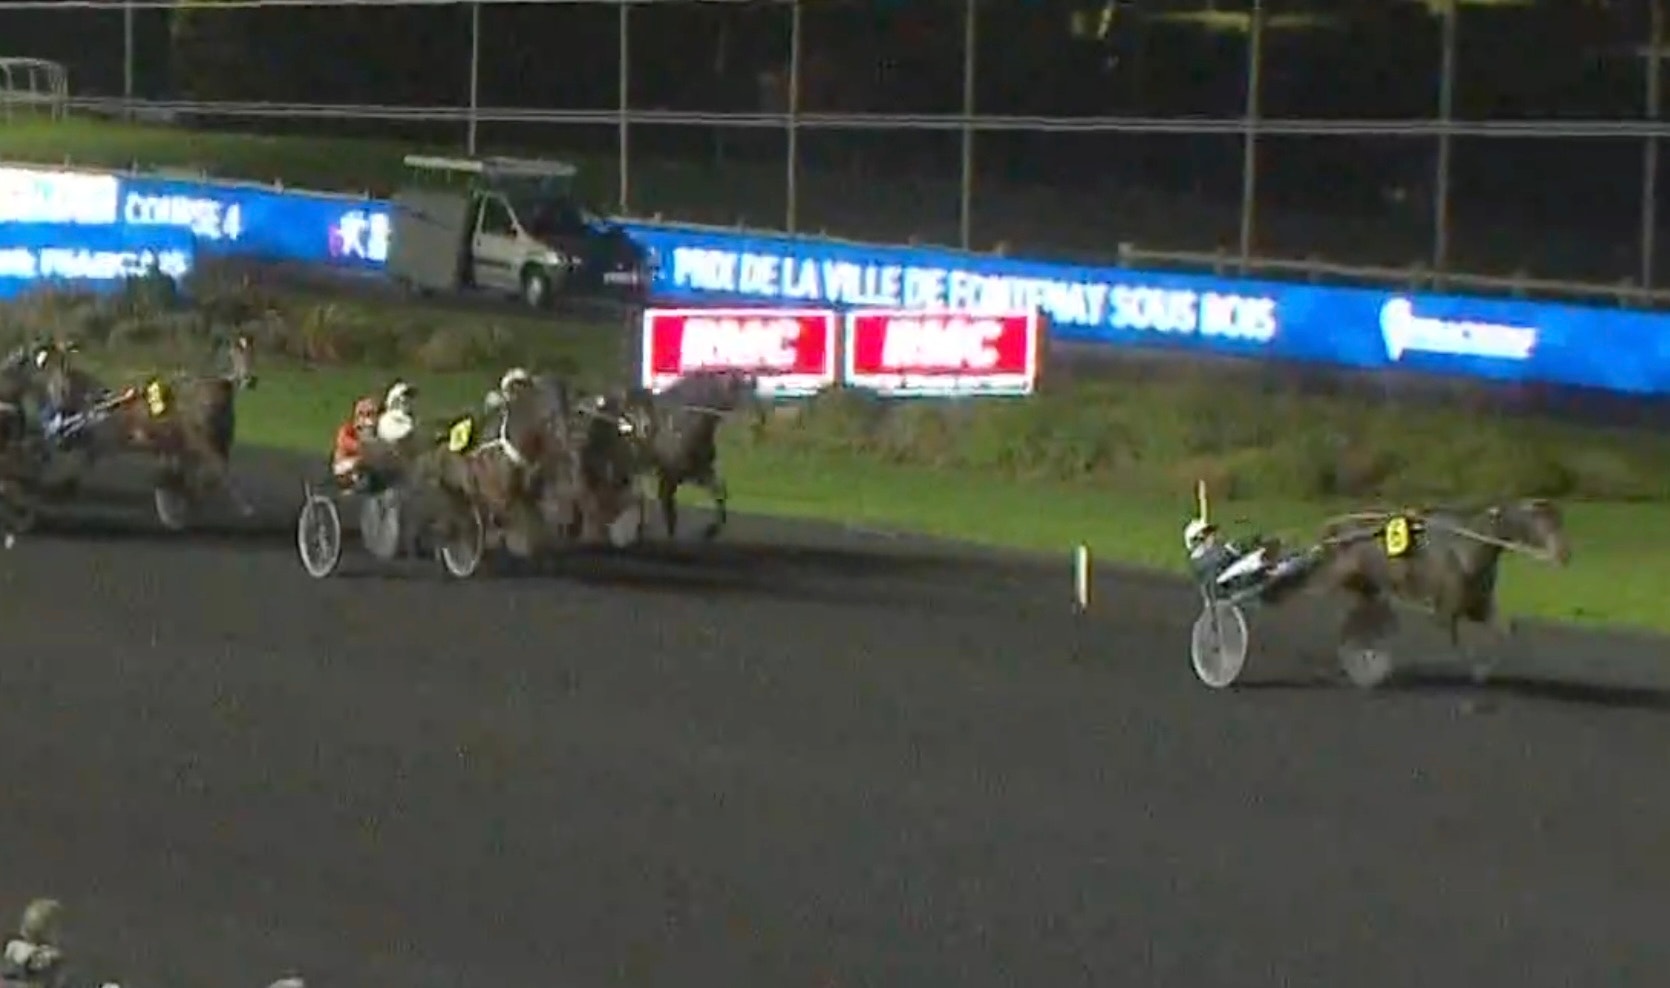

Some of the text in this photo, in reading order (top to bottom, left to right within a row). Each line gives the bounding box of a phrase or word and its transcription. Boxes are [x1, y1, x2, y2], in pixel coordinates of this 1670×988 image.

[676, 248, 736, 291] PRIX
[740, 254, 779, 295] DE
[783, 258, 819, 299] LA
[824, 262, 901, 305] VILLE
[905, 268, 946, 309] DE
[1111, 285, 1197, 332] SOUS
[1202, 294, 1276, 340] BOIS
